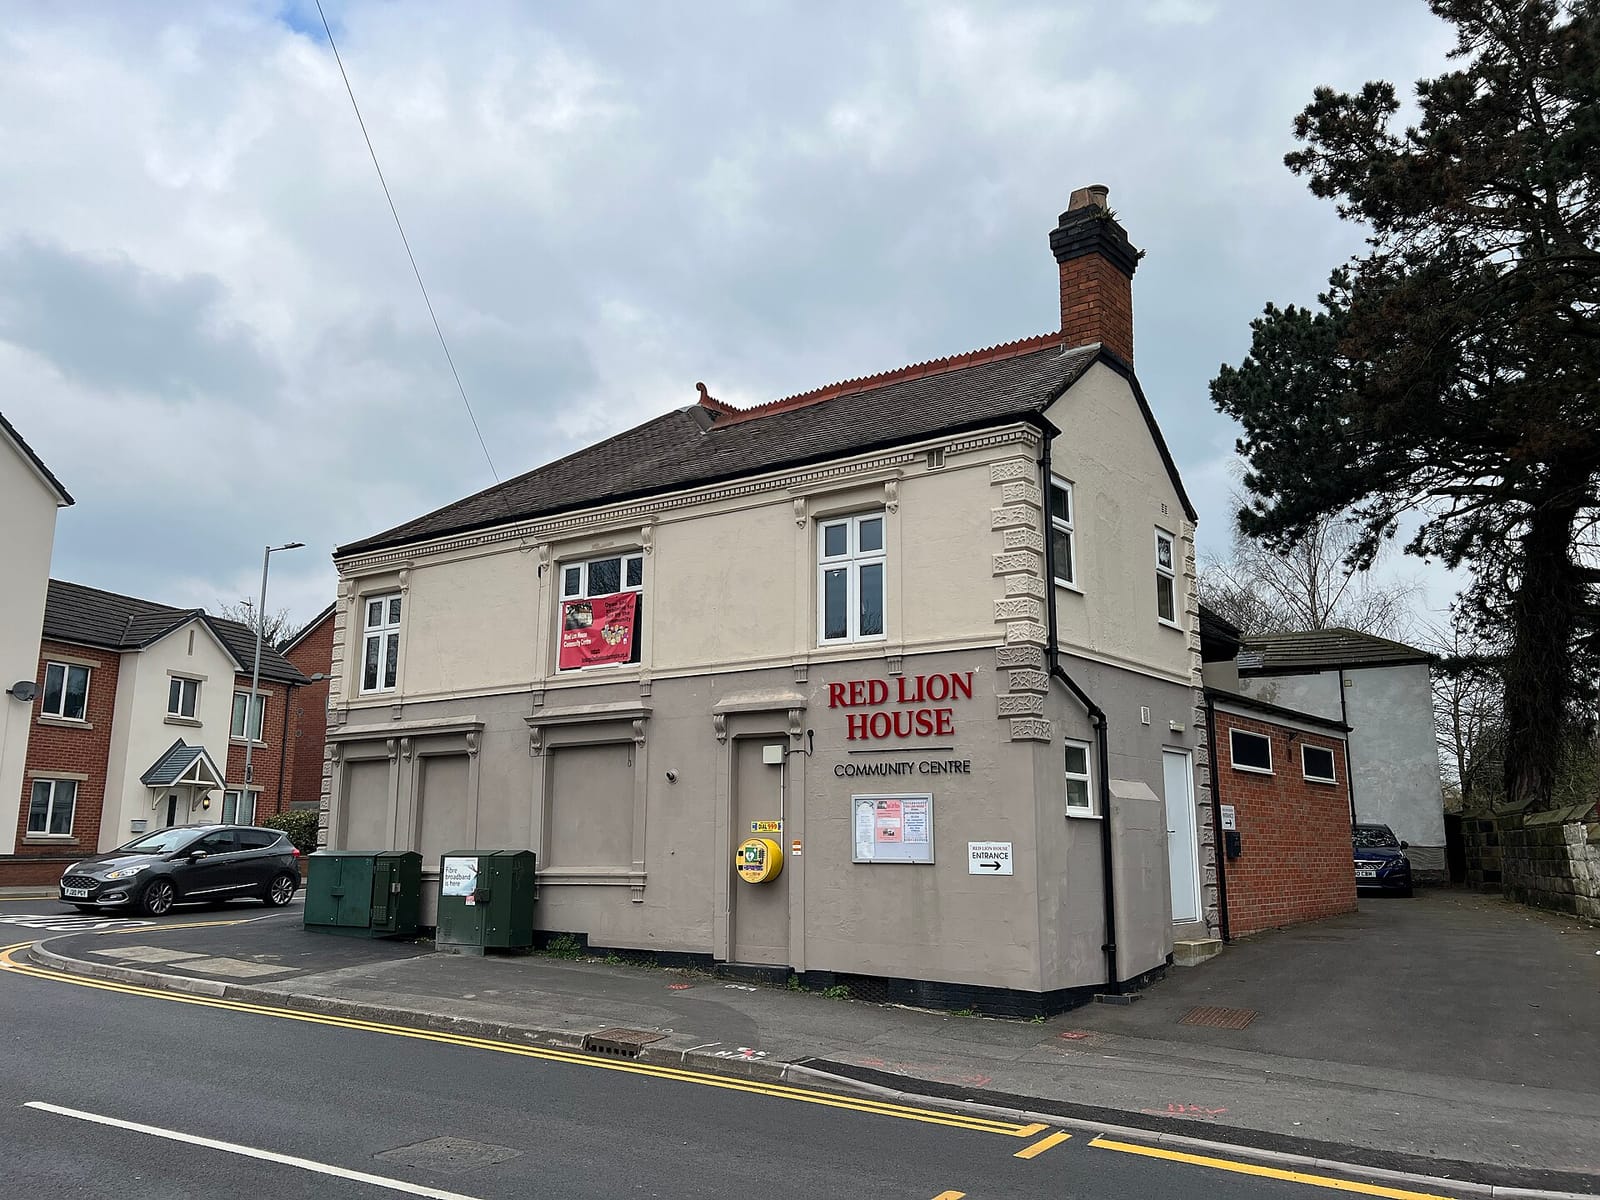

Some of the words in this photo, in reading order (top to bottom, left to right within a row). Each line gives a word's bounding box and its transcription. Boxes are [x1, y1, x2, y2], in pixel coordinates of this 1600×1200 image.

[828, 679, 889, 709] RED
[896, 671, 974, 704] LION
[845, 708, 955, 741] HOUSE
[834, 761, 915, 778] COMMUNITY
[918, 760, 971, 775] CENTRE
[972, 852, 1009, 860] ENTRANCE
[445, 866, 458, 874] Fibre
